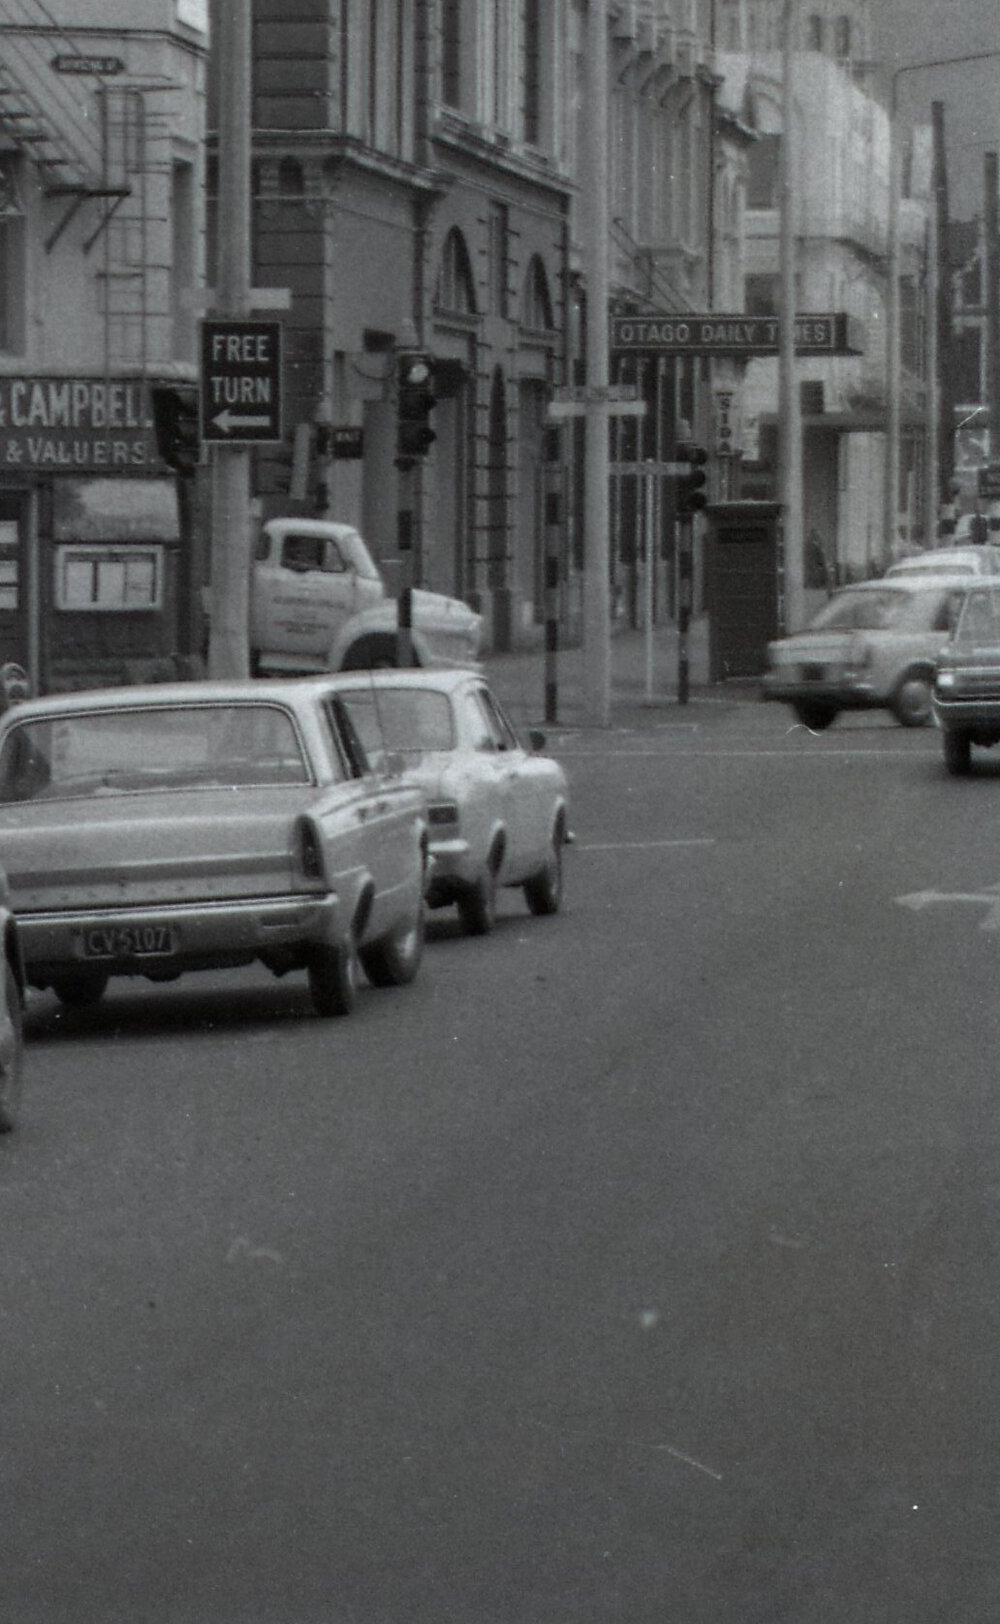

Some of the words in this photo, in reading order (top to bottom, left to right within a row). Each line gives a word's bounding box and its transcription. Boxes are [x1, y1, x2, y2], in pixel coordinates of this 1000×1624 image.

[620, 323, 690, 343] OTAGO
[701, 323, 755, 343] DAILY
[766, 324, 826, 343] TES
[212, 334, 270, 363] FREE
[210, 376, 271, 404] TURN
[6, 439, 23, 464] &
